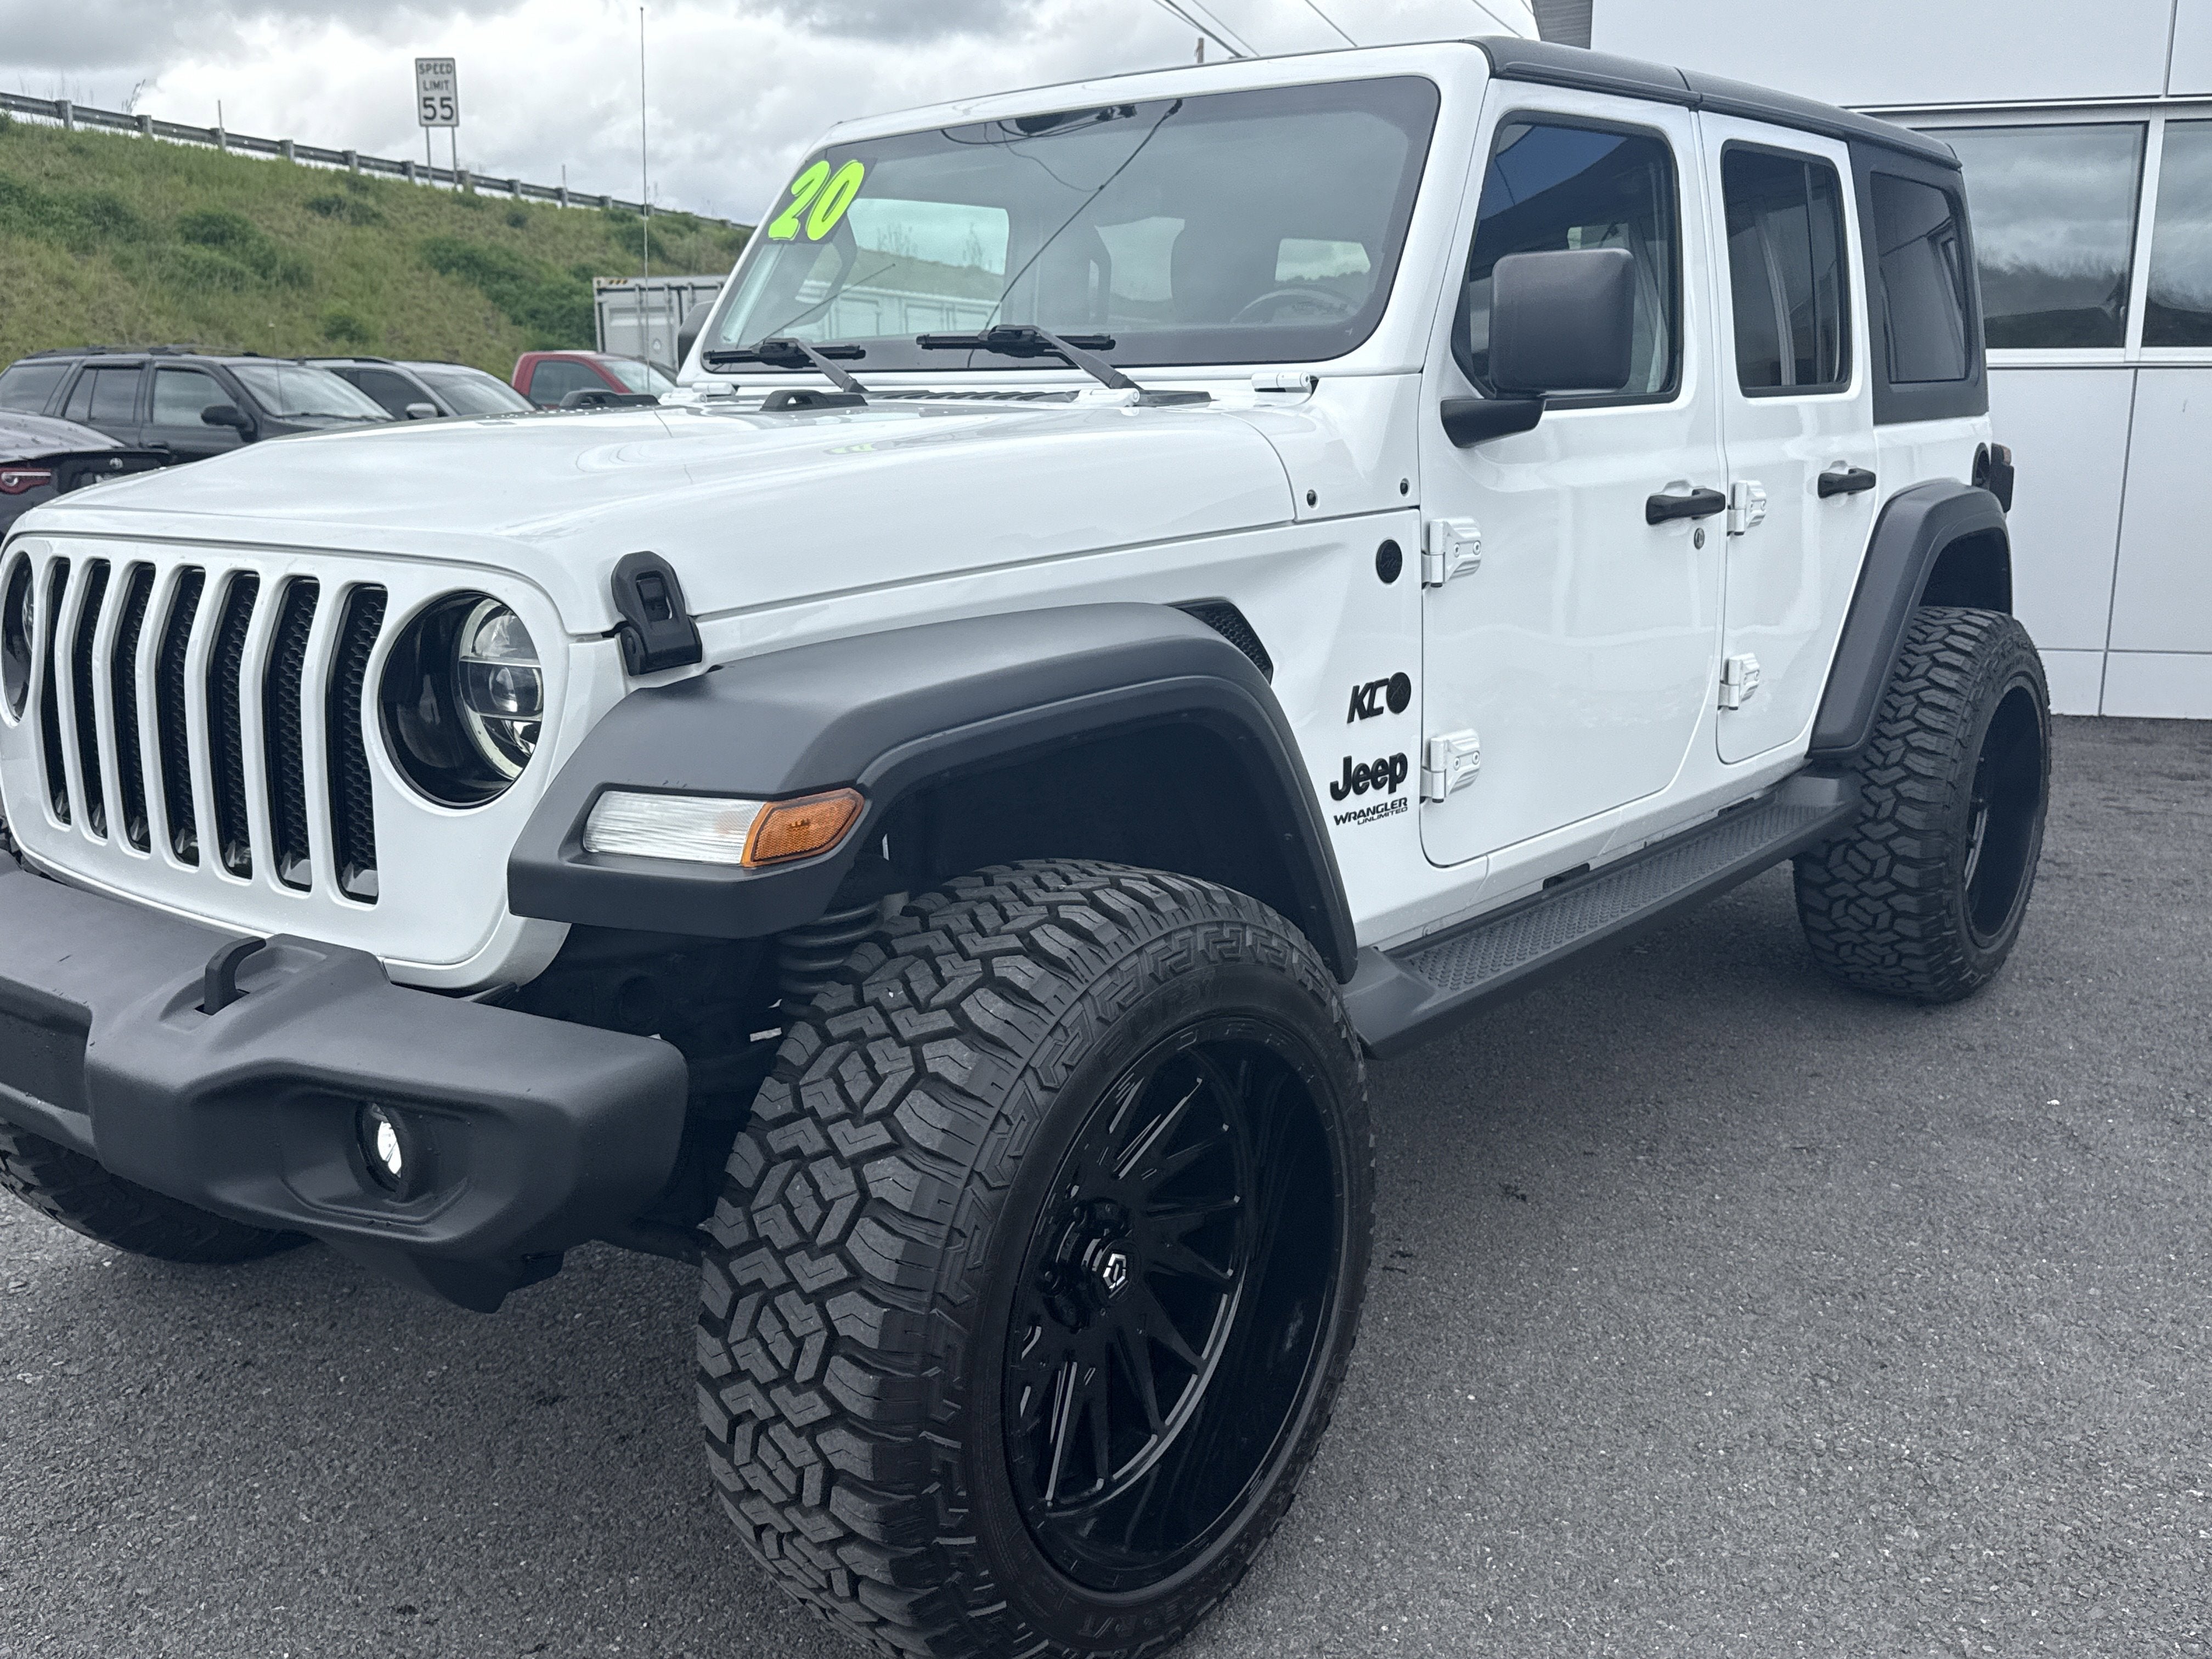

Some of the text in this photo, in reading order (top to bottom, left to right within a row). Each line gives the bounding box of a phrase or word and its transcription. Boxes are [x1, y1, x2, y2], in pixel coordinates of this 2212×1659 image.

[419, 63, 453, 75] SPEED
[422, 80, 449, 91] LIMIT
[422, 97, 454, 121] 55
[768, 160, 865, 241] 20
[1330, 752, 1408, 801] Jeep
[1333, 797, 1408, 826] WRANGLER
[1357, 806, 1408, 825] UNLIMITED
